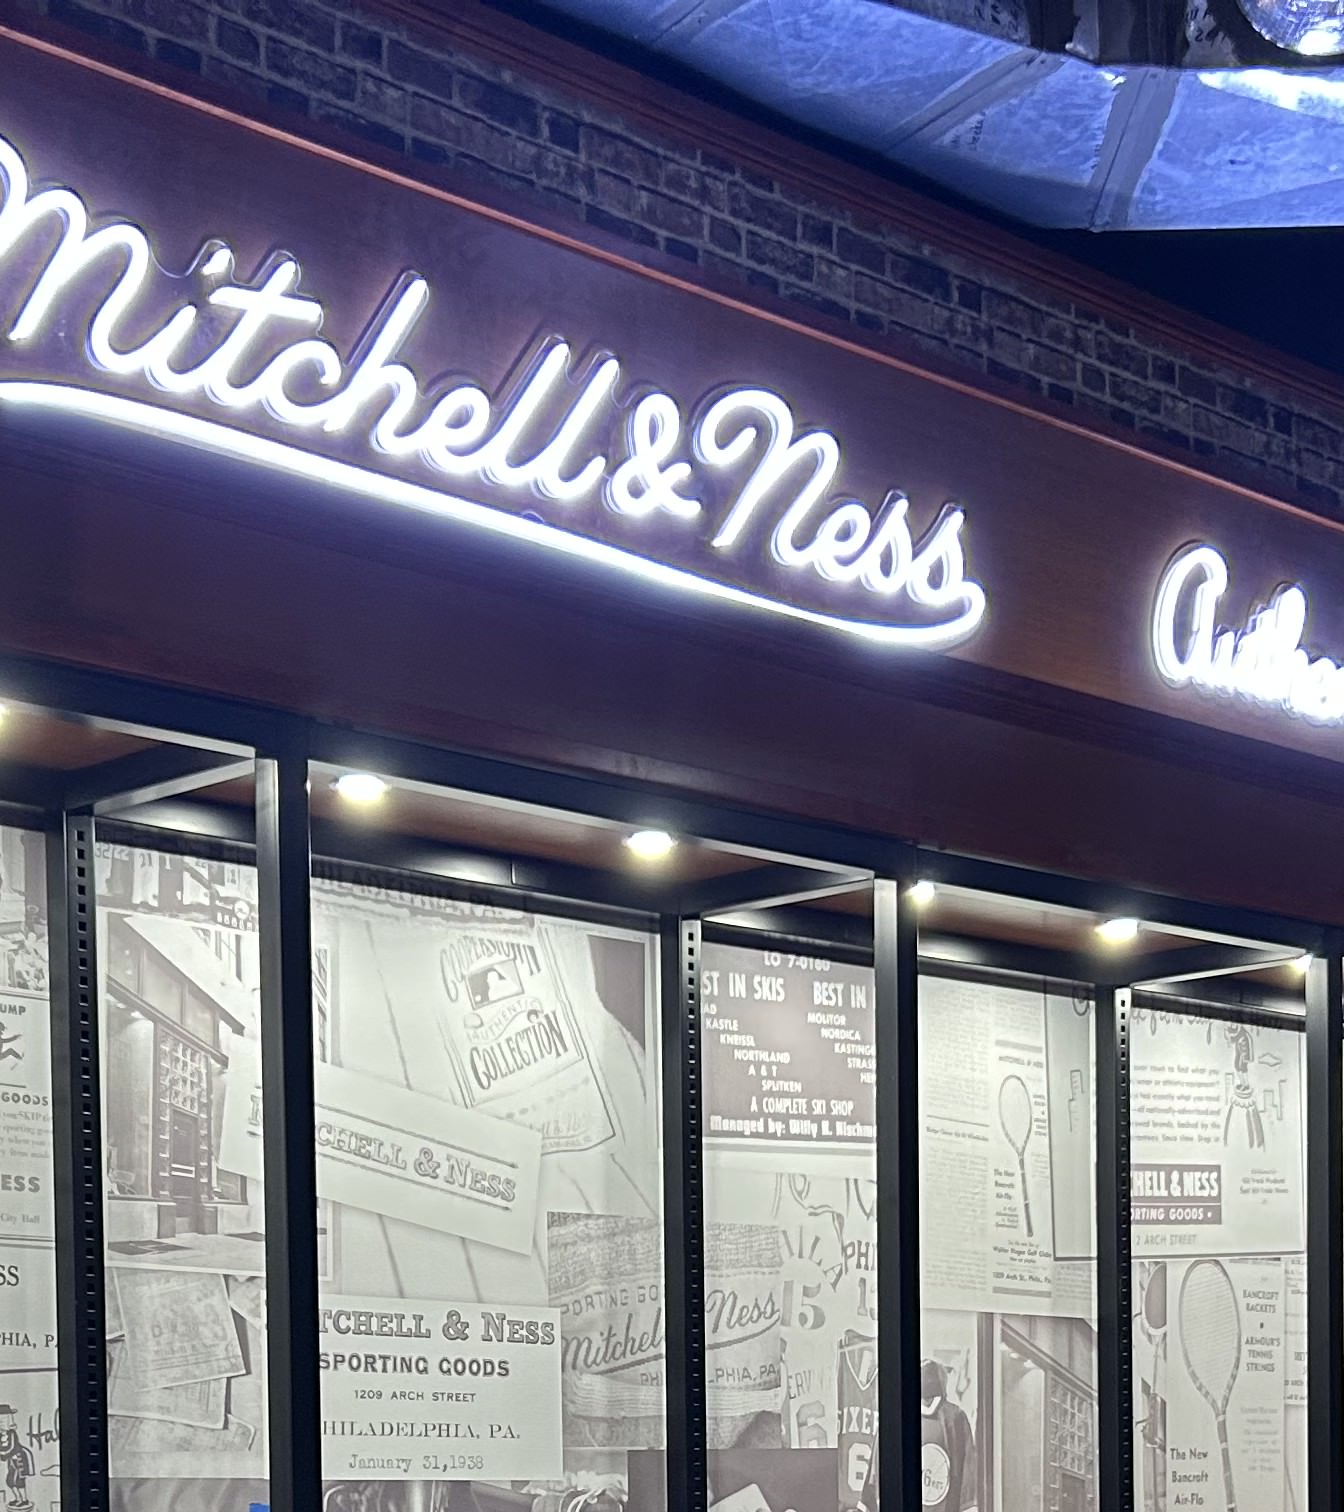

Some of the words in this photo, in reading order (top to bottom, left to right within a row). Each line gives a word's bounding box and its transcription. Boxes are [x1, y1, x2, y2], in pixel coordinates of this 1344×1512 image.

[608, 396, 702, 520] &
[696, 386, 984, 608] Ness
[728, 972, 747, 999] IN
[753, 974, 786, 1002] SKIS
[813, 981, 844, 1007] BEST
[850, 984, 867, 1009] IN
[820, 1028, 861, 1041] NORDICA
[469, 1010, 570, 1091] COLLECTION
[734, 1049, 791, 1064] NORTHLAND
[1, 1091, 49, 1107] GOODS
[763, 1097, 808, 1115] COMPLETE
[812, 1099, 827, 1115] SKI
[830, 1099, 854, 1116] SHOP
[413, 1146, 441, 1180] &
[442, 1152, 517, 1204] NESS
[1168, 1207, 1205, 1221] GOODS
[704, 1287, 782, 1335] Ness
[442, 1308, 470, 1341] &
[481, 1311, 556, 1345] NESS
[439, 1356, 511, 1378] GOODS
[354, 1389, 384, 1401] 1209
[391, 1390, 425, 1401] ARCH
[432, 1391, 478, 1403] STREET
[488, 1424, 521, 1440] PA.
[348, 1453, 413, 1473] January
[422, 1454, 485, 1474] 31,1938
[1170, 1448, 1187, 1461] The
[1189, 1448, 1209, 1460] New
[1171, 1471, 1209, 1484] Bancroft
[1174, 1493, 1205, 1506] Air-Flo
